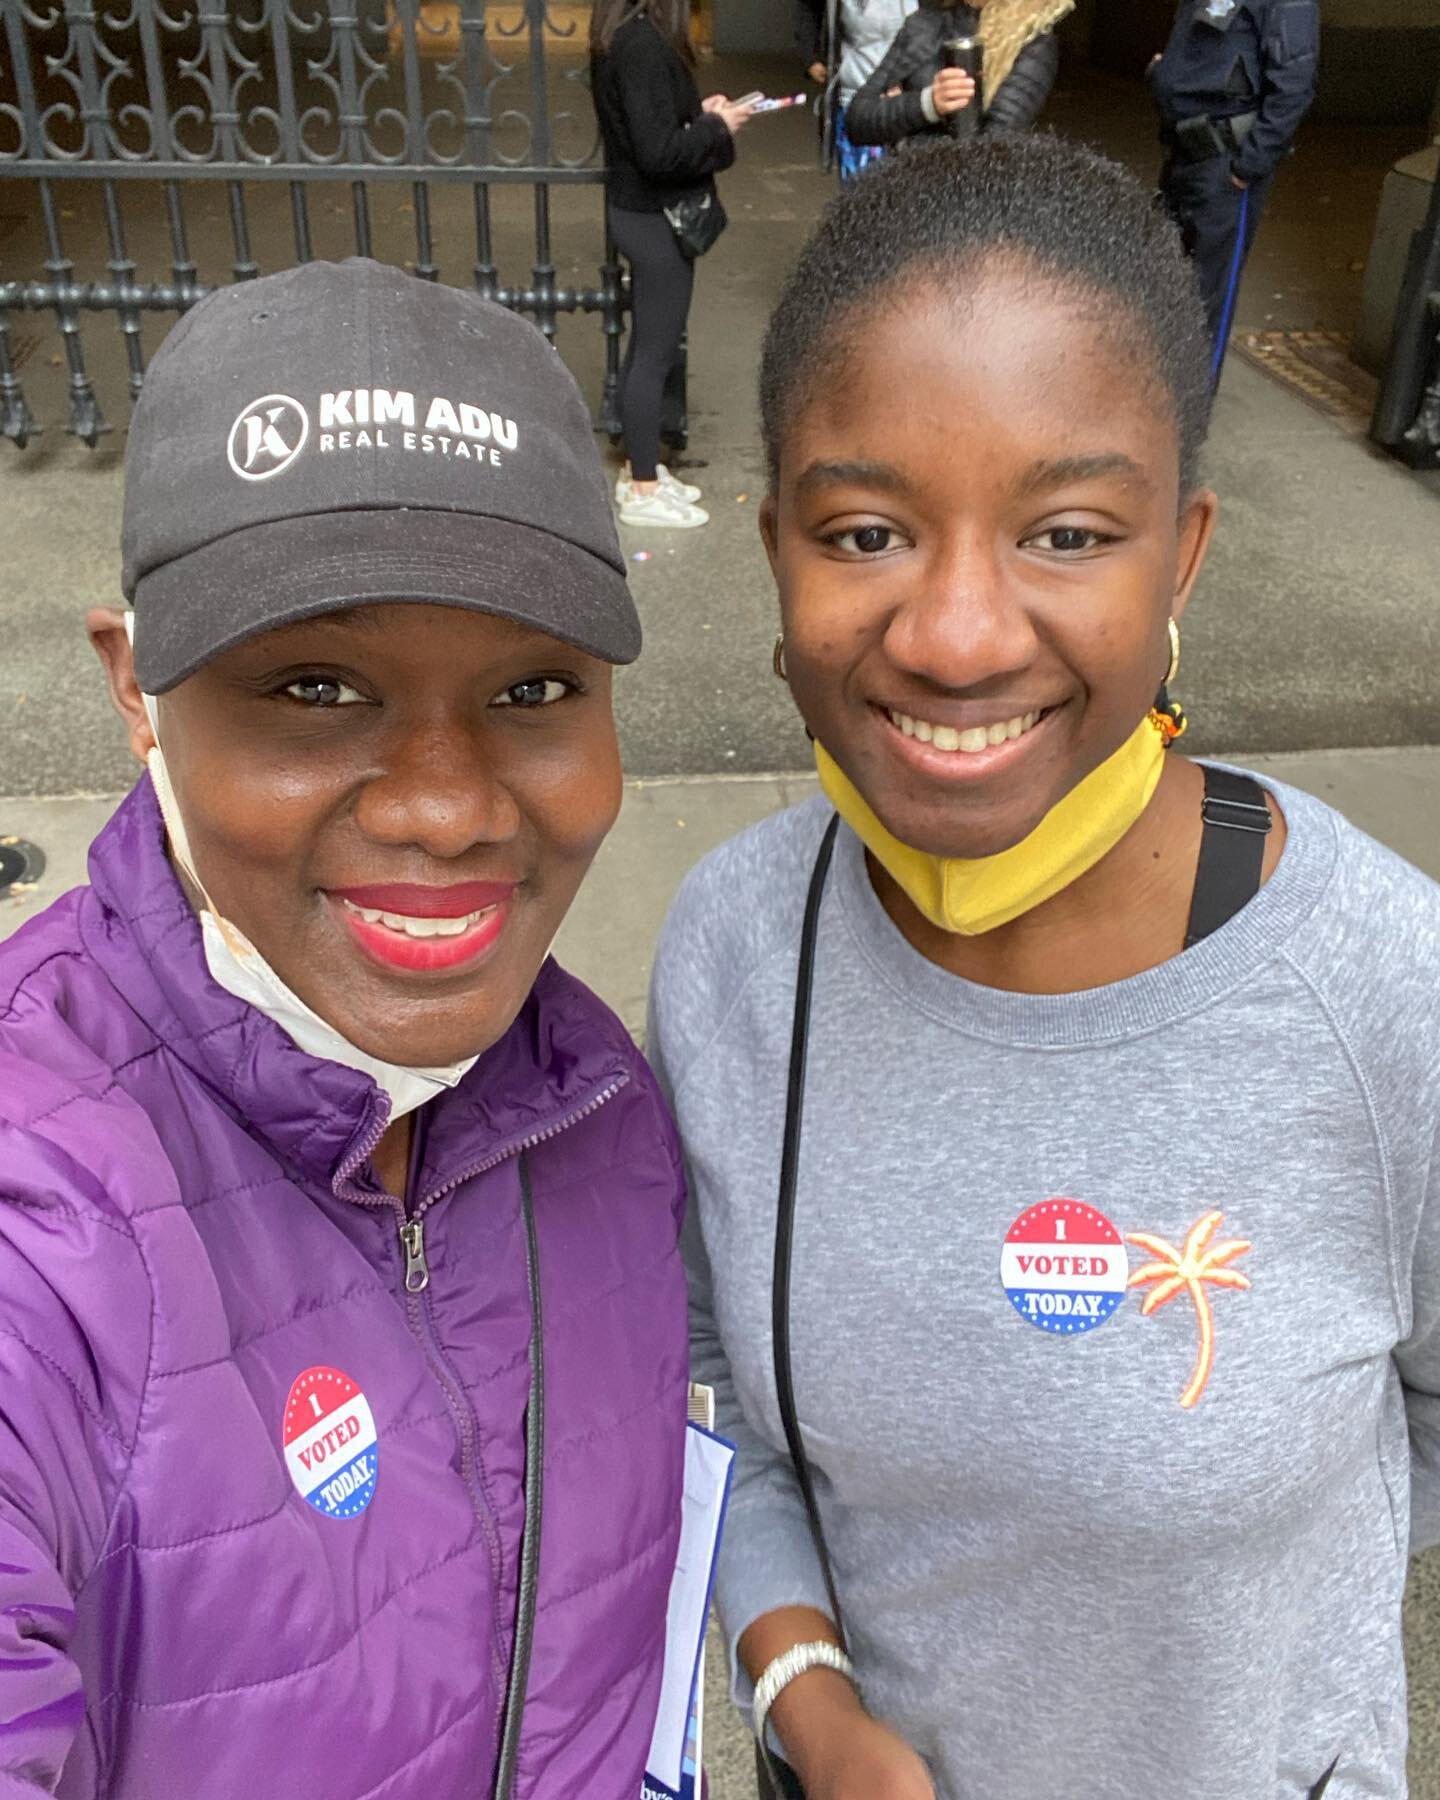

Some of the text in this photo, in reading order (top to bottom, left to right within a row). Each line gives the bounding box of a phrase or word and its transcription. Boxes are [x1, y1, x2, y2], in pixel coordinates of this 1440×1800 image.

[319, 389, 519, 449] KIM ADU
[320, 429, 502, 466] REAL ESTATE
[1055, 1219, 1067, 1240] I
[1015, 1255, 1109, 1276] VOTED
[1024, 1293, 1103, 1316] TODAY
[308, 1392, 324, 1418] I
[297, 1415, 361, 1471] VOTED
[320, 1455, 372, 1511] TODAY
